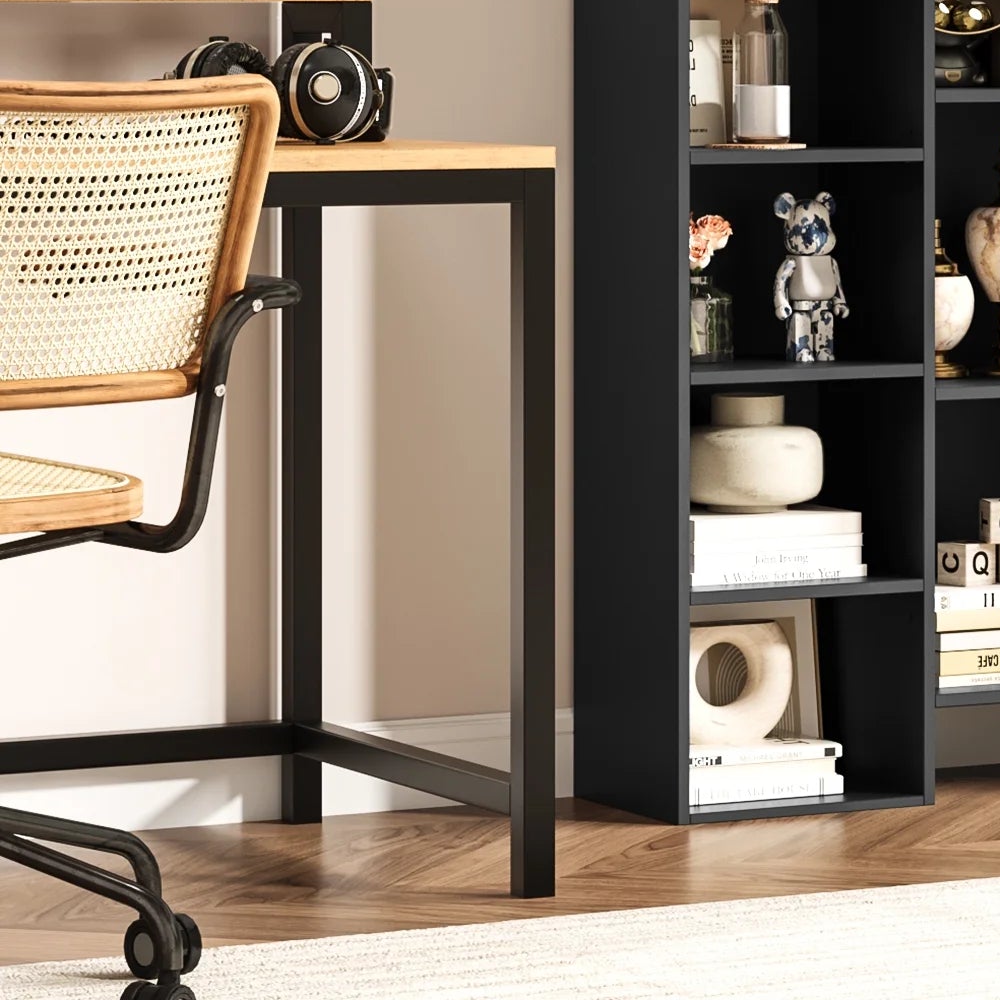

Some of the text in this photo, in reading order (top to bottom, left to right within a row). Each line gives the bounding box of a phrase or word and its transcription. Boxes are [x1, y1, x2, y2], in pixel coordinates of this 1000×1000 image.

[942, 552, 959, 574] C
[972, 551, 990, 576] Q
[818, 568, 840, 578] Year
[977, 654, 999, 670] CAFÉ
